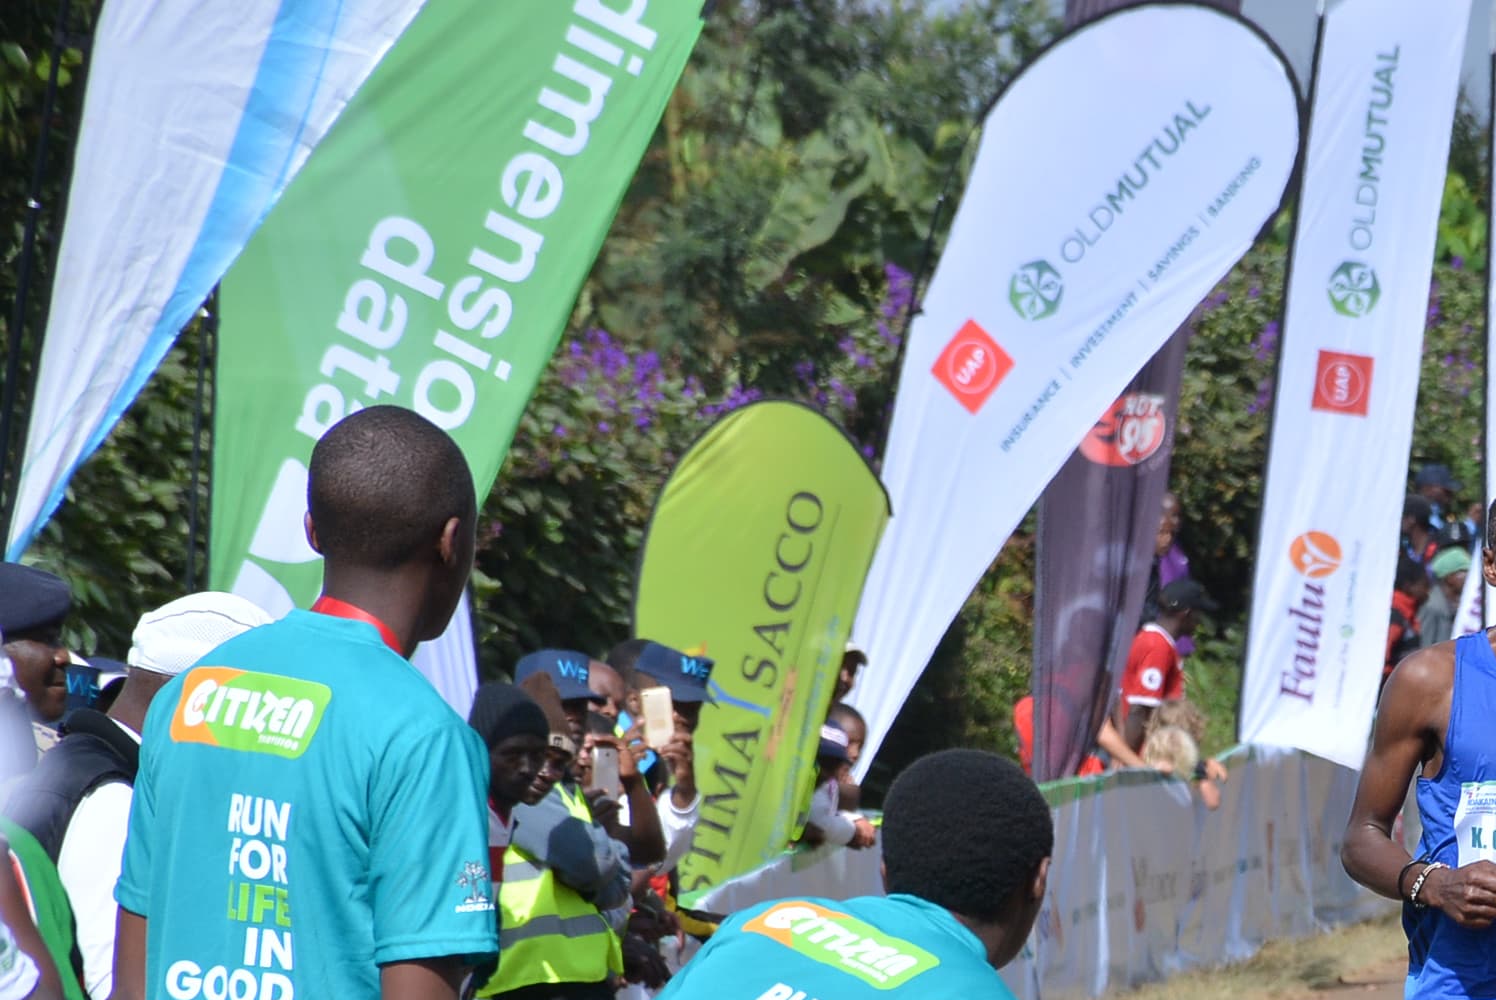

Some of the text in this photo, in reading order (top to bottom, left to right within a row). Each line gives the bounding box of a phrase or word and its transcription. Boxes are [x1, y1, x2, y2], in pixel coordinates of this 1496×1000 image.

[413, 0, 658, 430] dimensio
[296, 216, 445, 440] data
[1000, 156, 1262, 454] INSURANCE INVESTMENT SAVINGS BANKING
[956, 348, 986, 385] UAP
[1334, 366, 1352, 402] UAP
[1124, 395, 1164, 417] HOT
[1281, 582, 1326, 703] Faulu
[679, 724, 761, 894] STIMA
[741, 491, 824, 689] SACCO
[227, 793, 291, 841] RUN
[1471, 826, 1488, 850] K.
[229, 837, 289, 885] FOR
[227, 880, 292, 928] LIFE
[243, 927, 293, 970] IN
